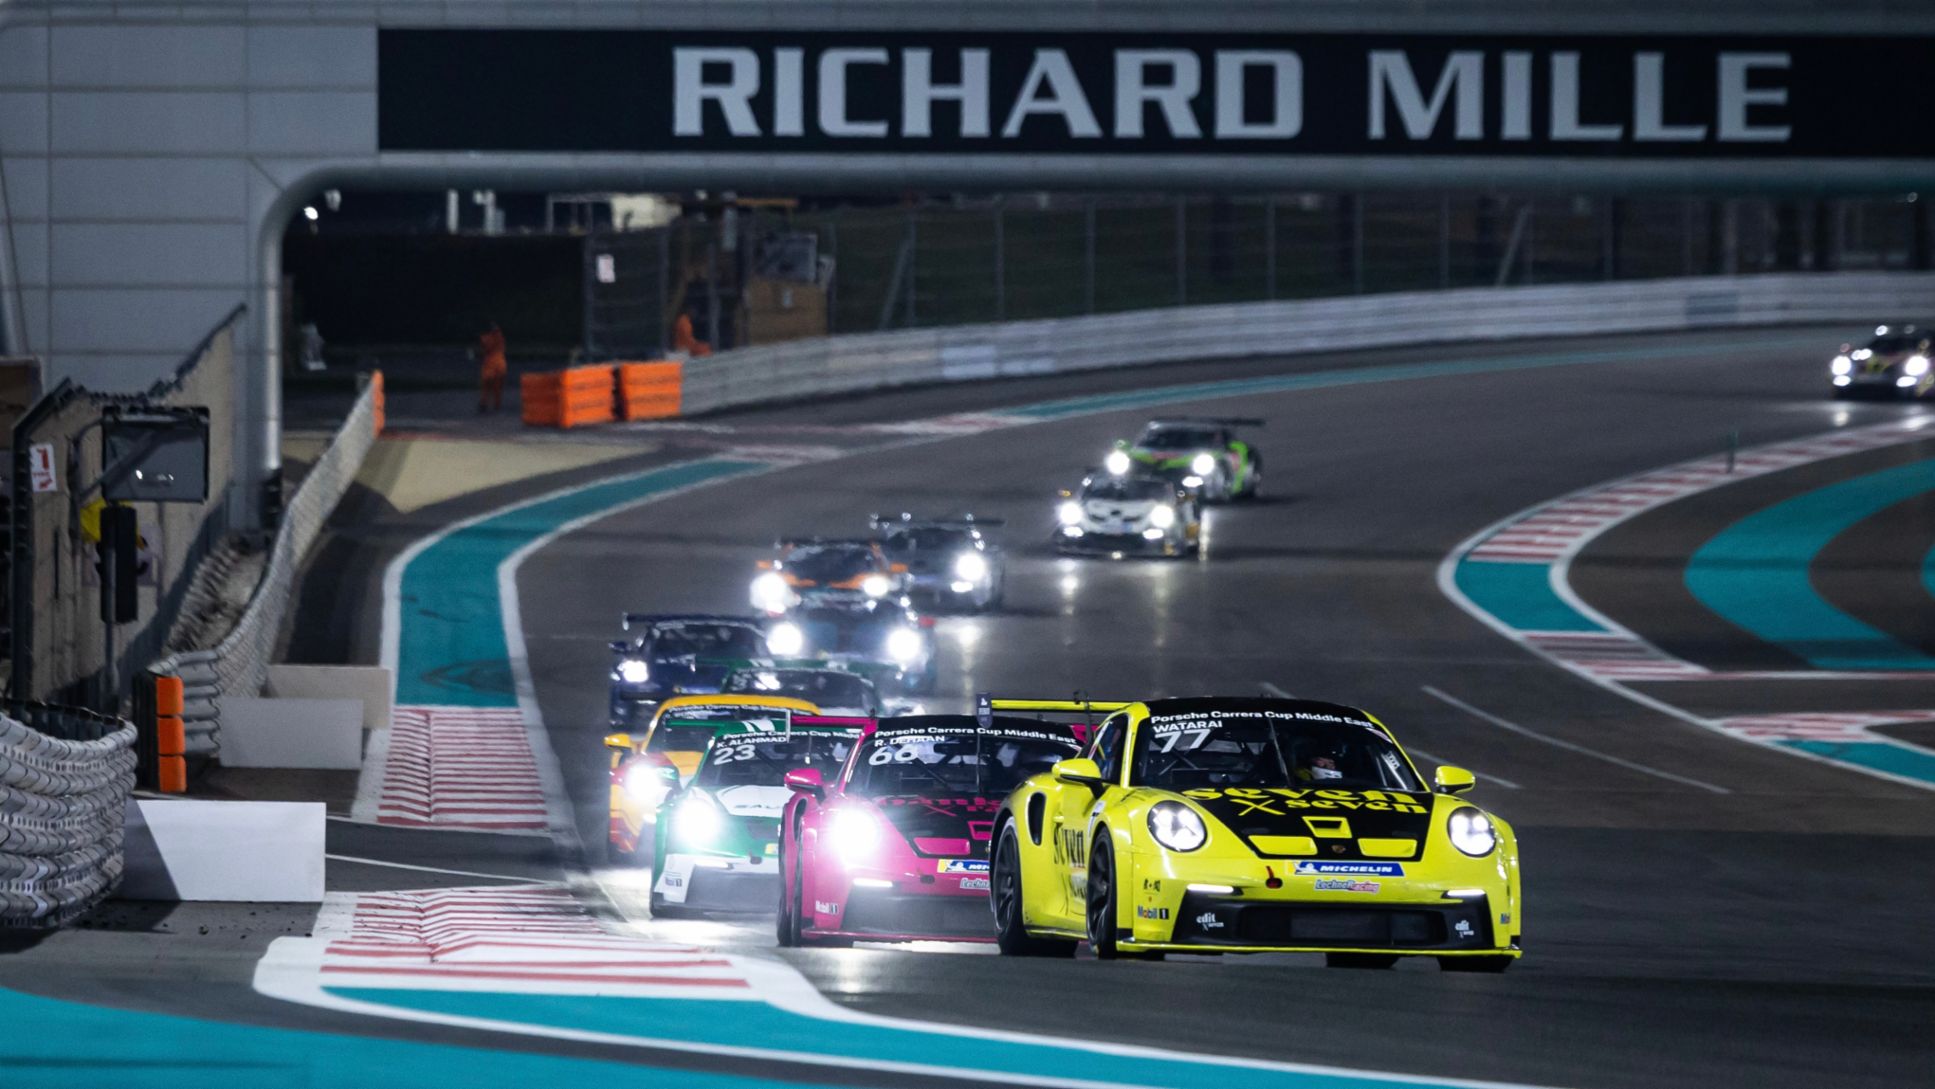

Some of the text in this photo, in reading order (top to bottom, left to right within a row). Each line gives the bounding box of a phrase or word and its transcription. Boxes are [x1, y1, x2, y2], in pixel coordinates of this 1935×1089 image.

[672, 47, 1789, 141] RICHARD MILLE
[1151, 710, 1375, 729] Porsche Carrera Cup Middle East
[1152, 720, 1223, 734] WATARAI
[723, 731, 767, 740] Porsche
[809, 730, 831, 739] Cup
[730, 736, 787, 747] ALAHMAD
[874, 726, 1078, 744] Porsche Carrera Cup Middle East
[874, 736, 946, 748] R. DEHAAN
[1154, 728, 1212, 754] 77
[713, 744, 756, 766] 23
[868, 745, 919, 766] 66
[1285, 799, 1428, 814] seven
[1319, 864, 1394, 874] MICHELIN
[1137, 906, 1158, 919] Mobil
[1196, 912, 1216, 924] edit
